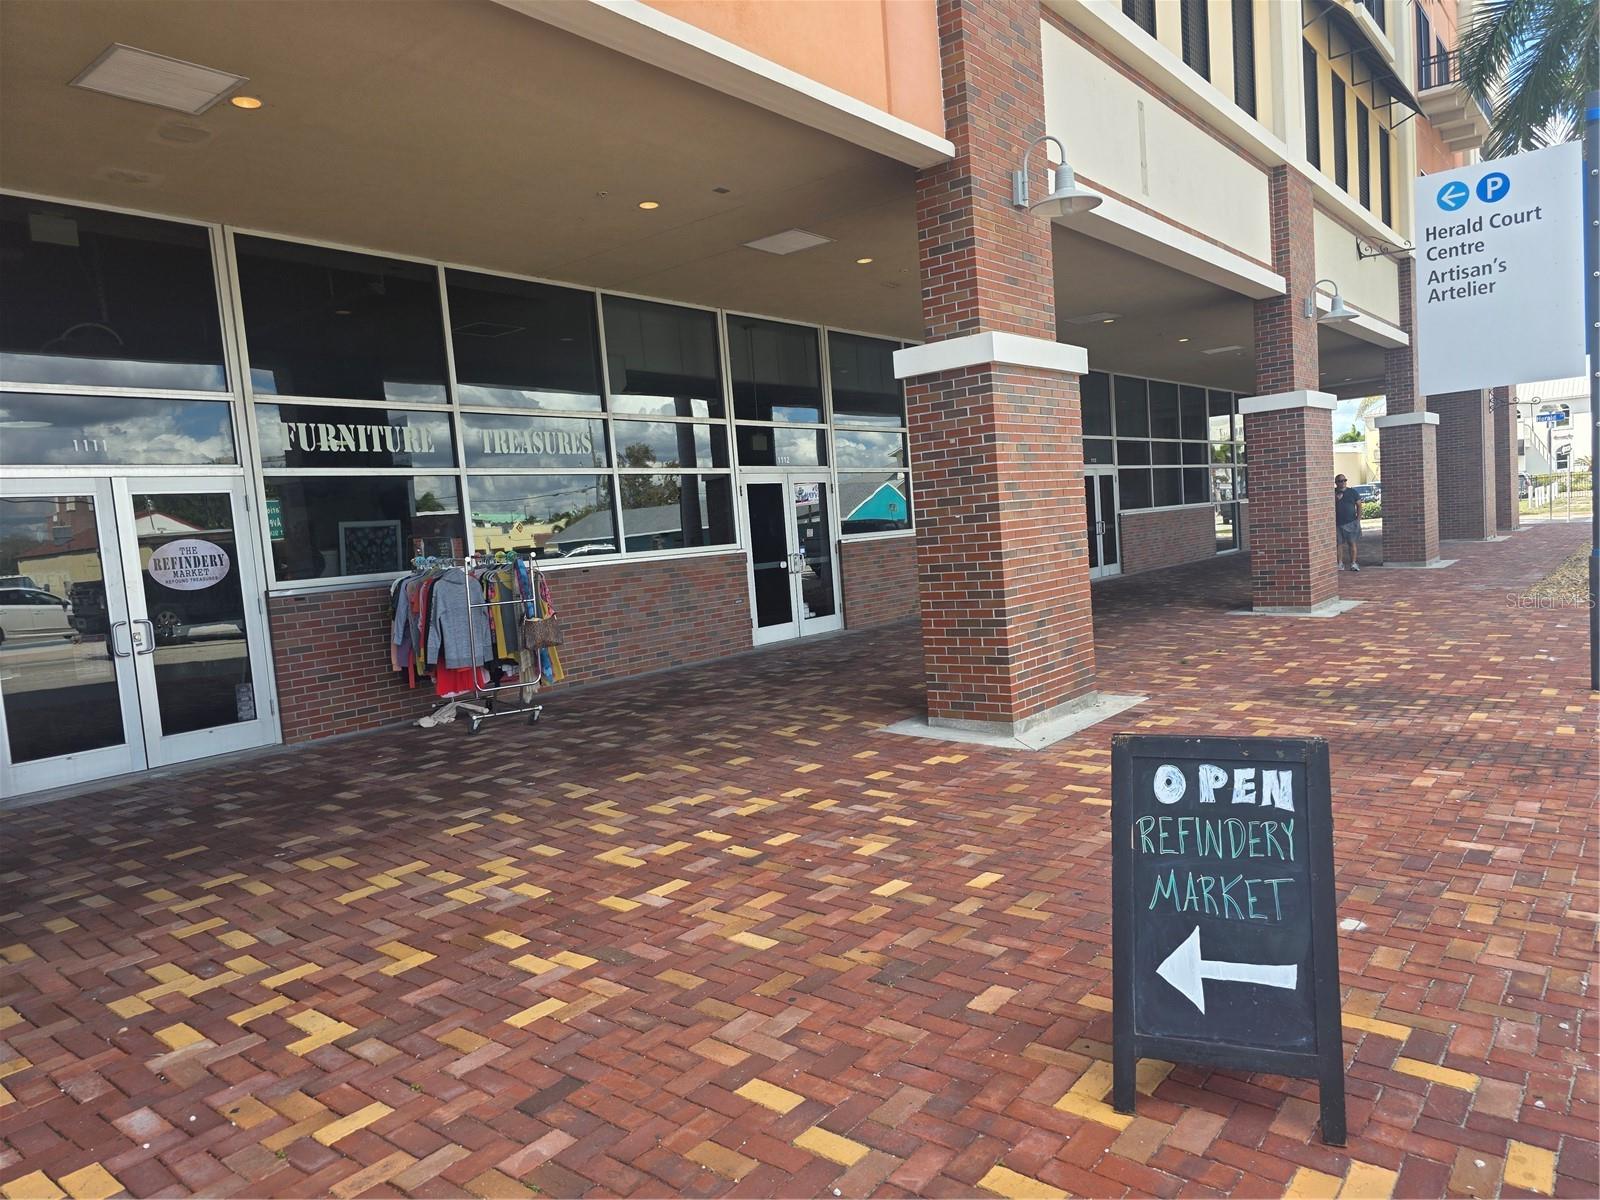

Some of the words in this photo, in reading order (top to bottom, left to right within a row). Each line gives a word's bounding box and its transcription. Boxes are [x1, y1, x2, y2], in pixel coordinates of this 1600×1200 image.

[1425, 215, 1483, 242] Herald
[1489, 205, 1543, 229] Court
[1426, 240, 1485, 262] Centre
[1427, 257, 1508, 286] Artisan's
[1427, 280, 1497, 304] Artelier
[72, 439, 108, 452] 1111
[280, 421, 436, 454] FURNITURE
[479, 428, 593, 456] TREASURES
[153, 553, 225, 571] REFINDERY
[179, 546, 198, 556] THE
[173, 568, 209, 578] MARKET
[1152, 763, 1296, 812] OPEN
[1136, 815, 1295, 861] REFINDERY
[1149, 868, 1295, 921] MARKET
